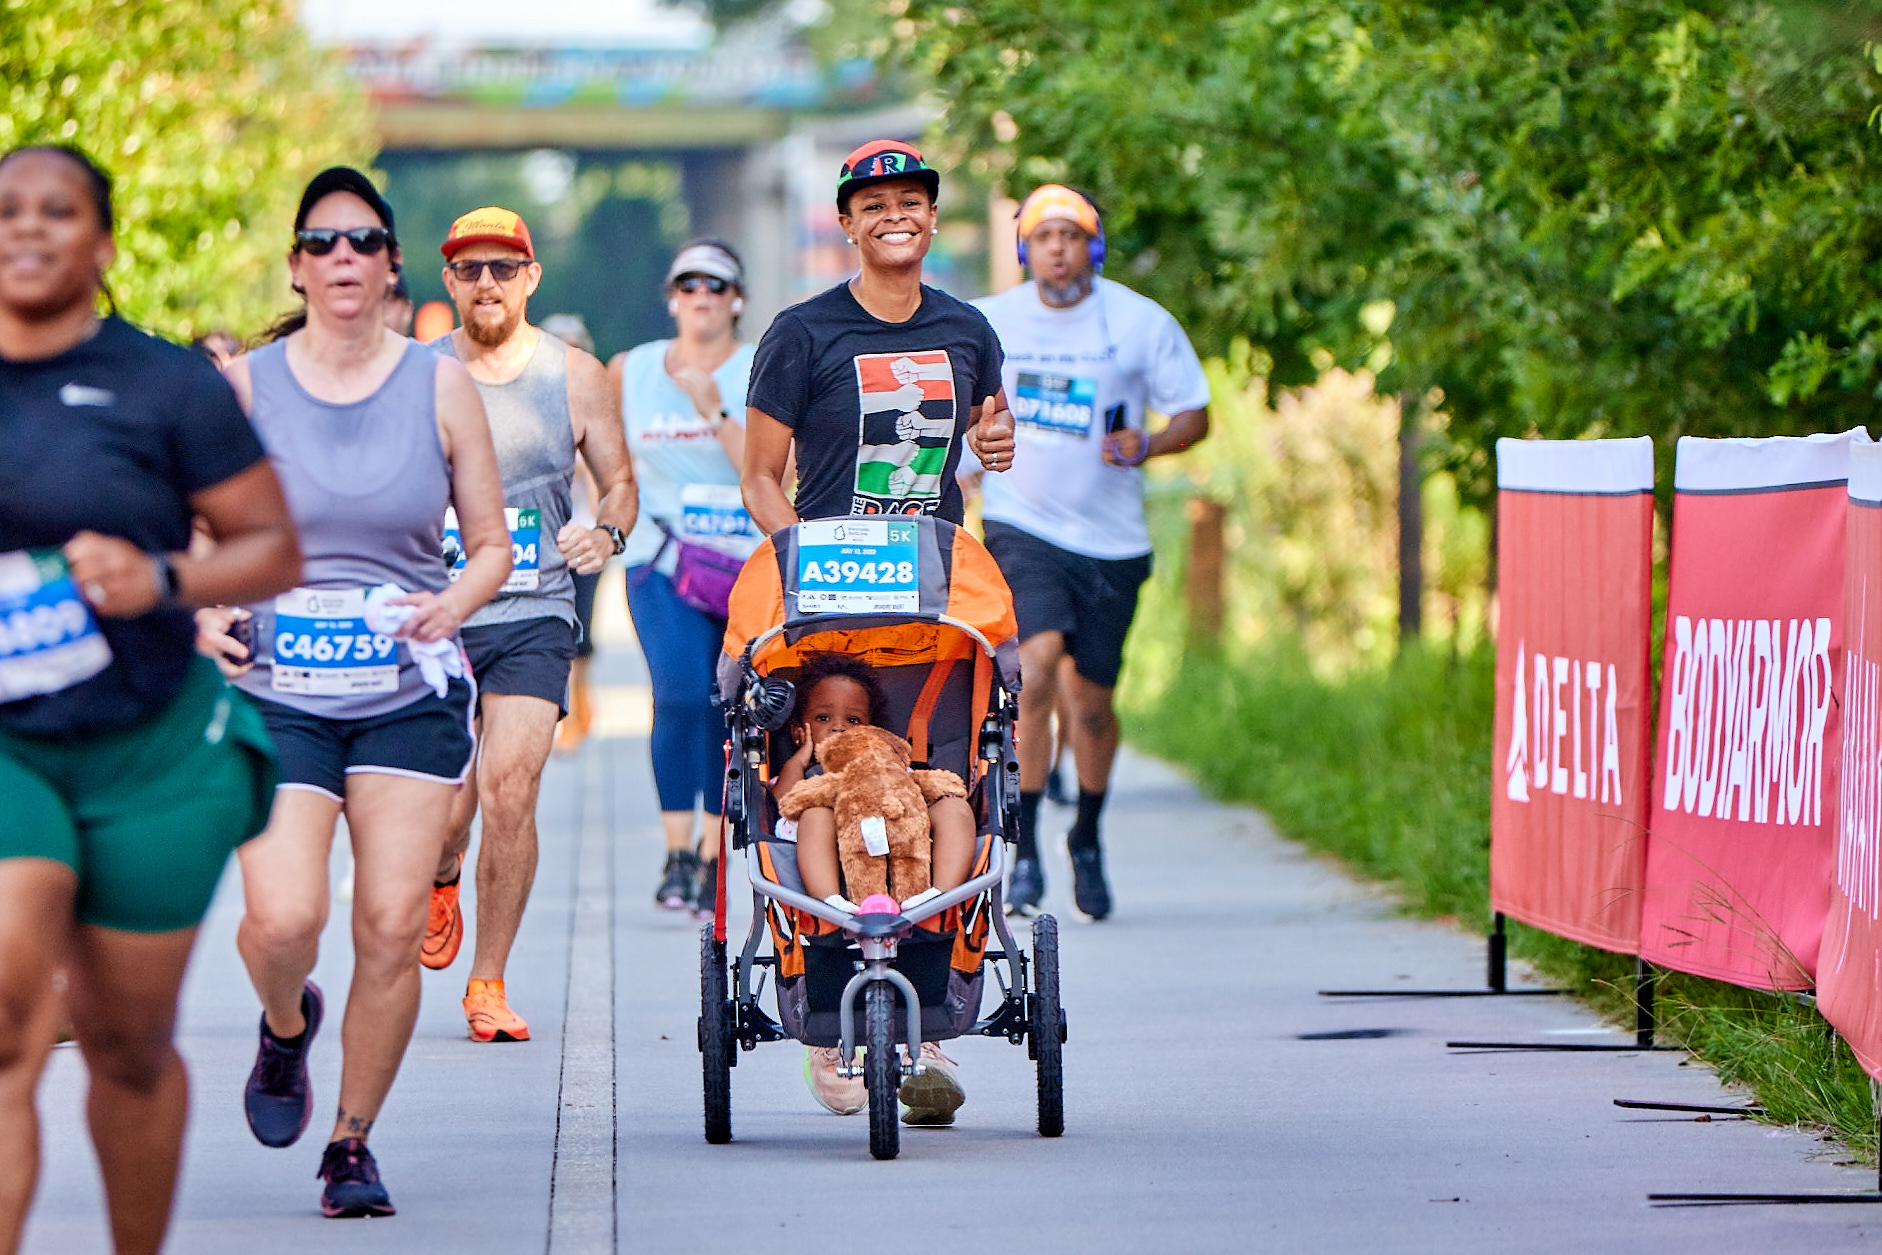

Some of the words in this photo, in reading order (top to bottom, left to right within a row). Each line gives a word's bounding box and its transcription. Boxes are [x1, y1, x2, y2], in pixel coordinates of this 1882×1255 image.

[889, 530, 912, 543] 5K
[801, 560, 915, 584] A39428
[276, 632, 395, 662] C46759
[1533, 653, 1622, 806] DELTA
[1663, 616, 1832, 827] BODYARMOR
